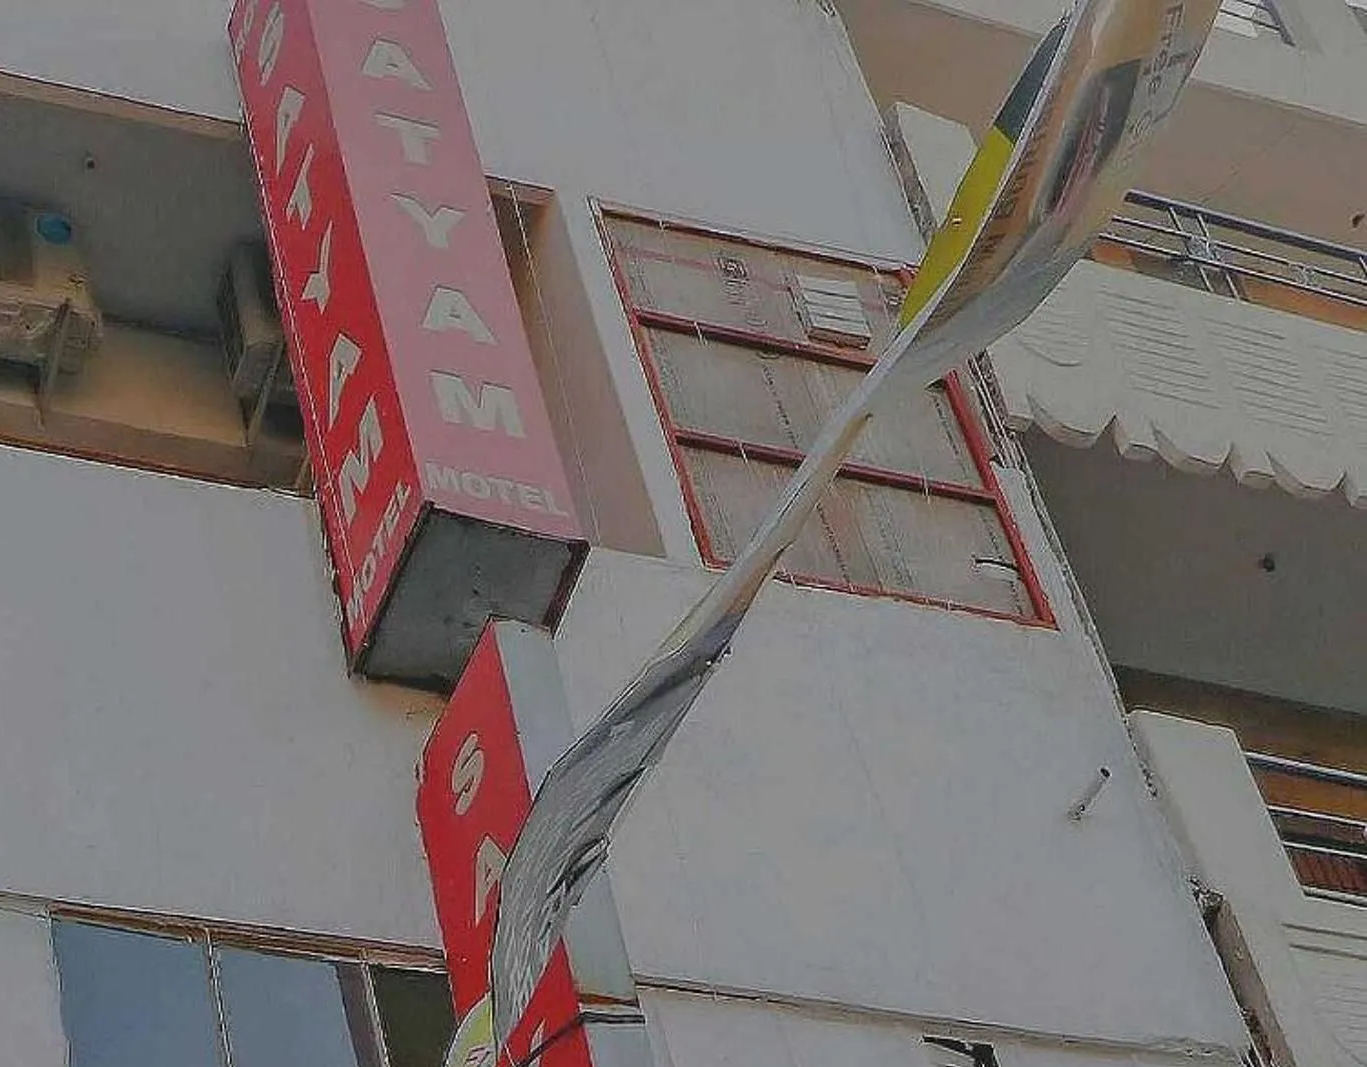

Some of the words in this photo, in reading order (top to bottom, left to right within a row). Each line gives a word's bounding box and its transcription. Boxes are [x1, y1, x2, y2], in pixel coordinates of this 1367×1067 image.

[258, 0, 382, 523] SATYAM
[357, 0, 527, 438] ATYAM
[346, 478, 411, 632] MOTEL
[425, 457, 571, 519] MOTEL
